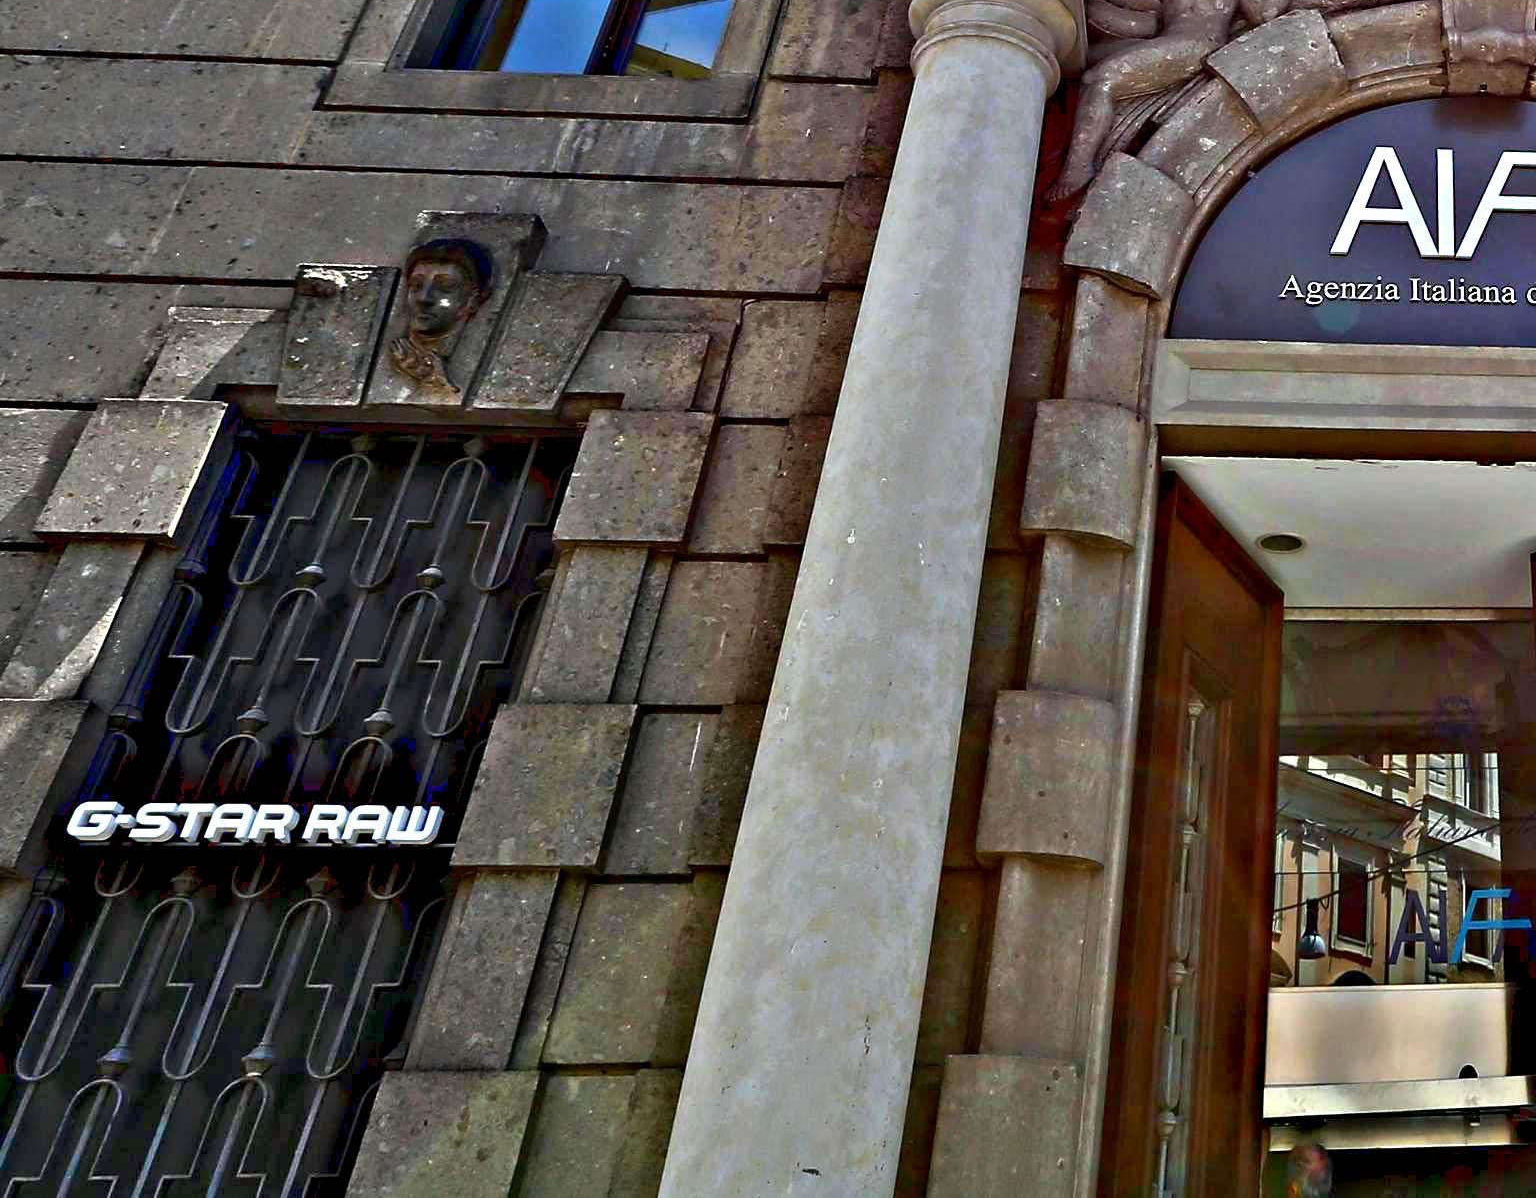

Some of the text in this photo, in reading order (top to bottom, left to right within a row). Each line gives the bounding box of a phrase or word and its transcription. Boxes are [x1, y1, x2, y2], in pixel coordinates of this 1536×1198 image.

[1279, 274, 1400, 305] Agenzia
[1409, 276, 1518, 304] Italiana
[65, 801, 445, 844] G-STAR RAW
